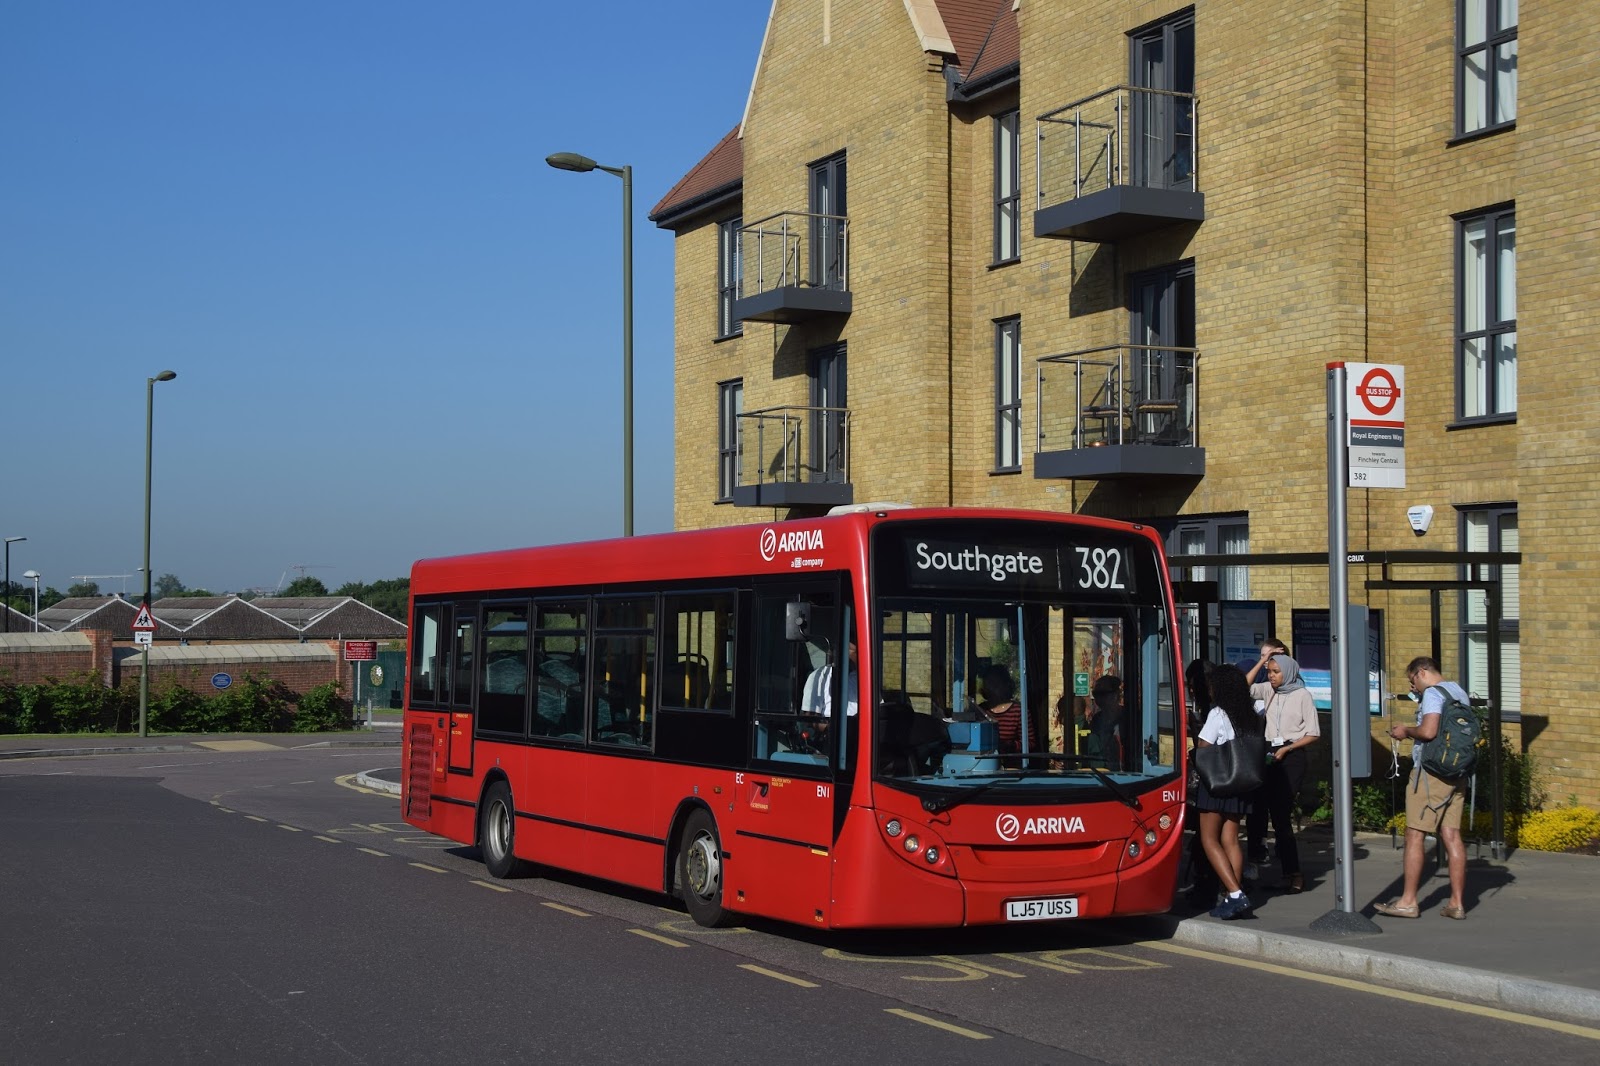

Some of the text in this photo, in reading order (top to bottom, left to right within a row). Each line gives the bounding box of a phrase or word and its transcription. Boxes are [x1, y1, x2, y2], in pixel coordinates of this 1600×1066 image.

[1378, 388, 1393, 396] STOP
[1352, 432, 1367, 440] Royal
[1368, 432, 1392, 441] Engineers
[1358, 456, 1379, 464] Finchley
[1353, 472, 1367, 481] 382
[777, 529, 824, 553] ARRIVA
[802, 558, 824, 568] company
[916, 542, 1044, 581] Southgate
[1075, 546, 1125, 589] 382
[735, 772, 745, 785] EC
[1023, 816, 1085, 834] ARRIVA
[1011, 900, 1072, 918] LJ57 USS
